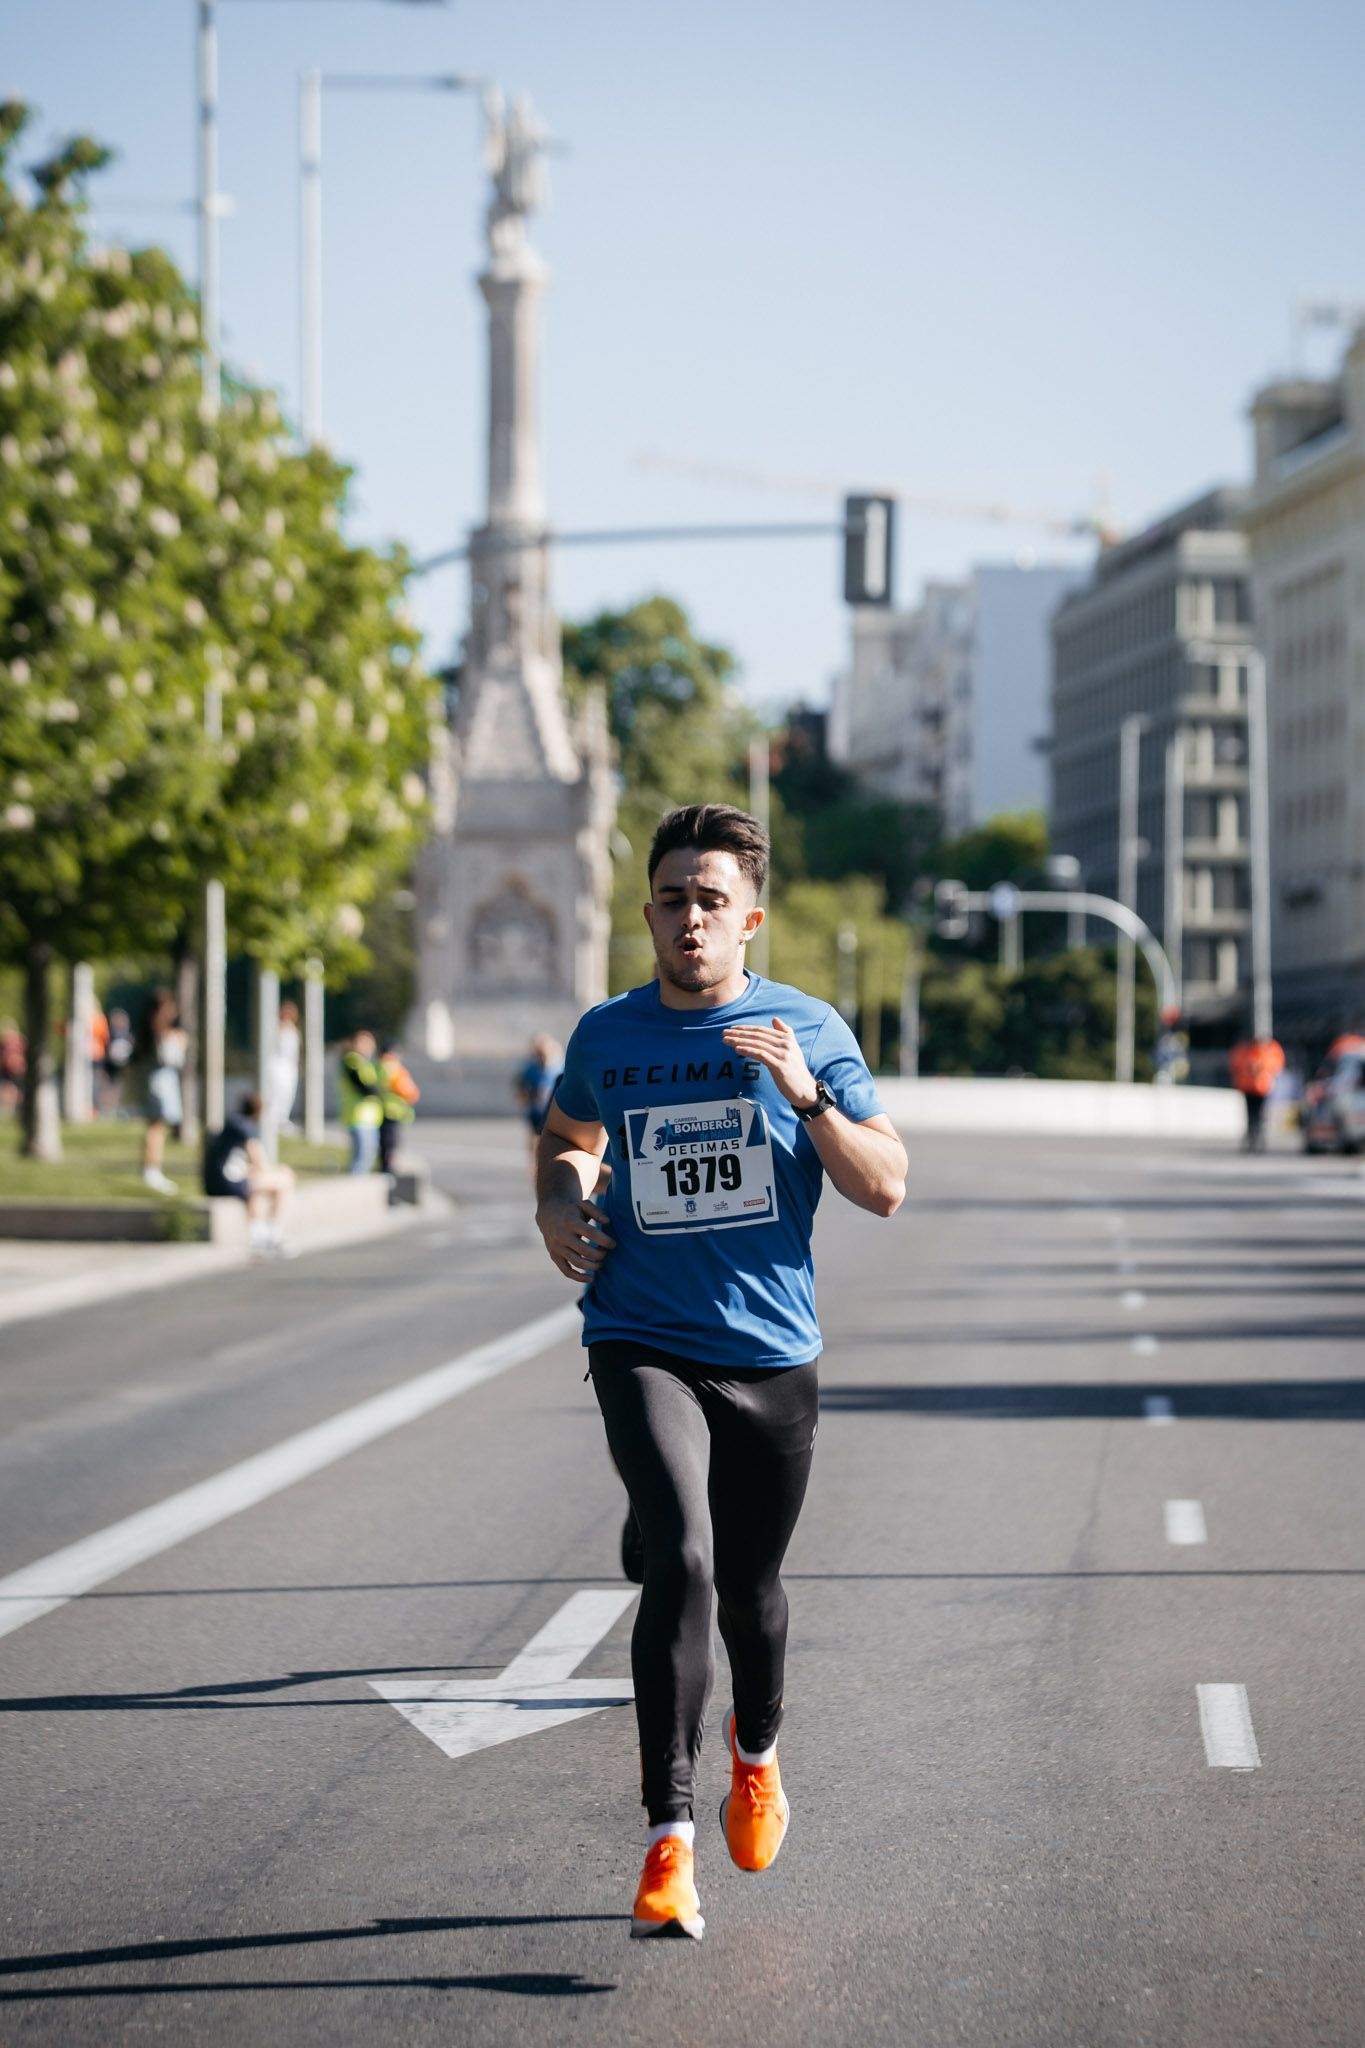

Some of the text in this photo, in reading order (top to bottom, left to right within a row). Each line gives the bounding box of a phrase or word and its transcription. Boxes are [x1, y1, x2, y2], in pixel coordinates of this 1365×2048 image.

[603, 1060, 761, 1089] DECIMAS
[674, 1118, 739, 1134] BOMBEROS
[669, 1139, 740, 1156] DECIMAS
[661, 1153, 742, 1197] 1379
